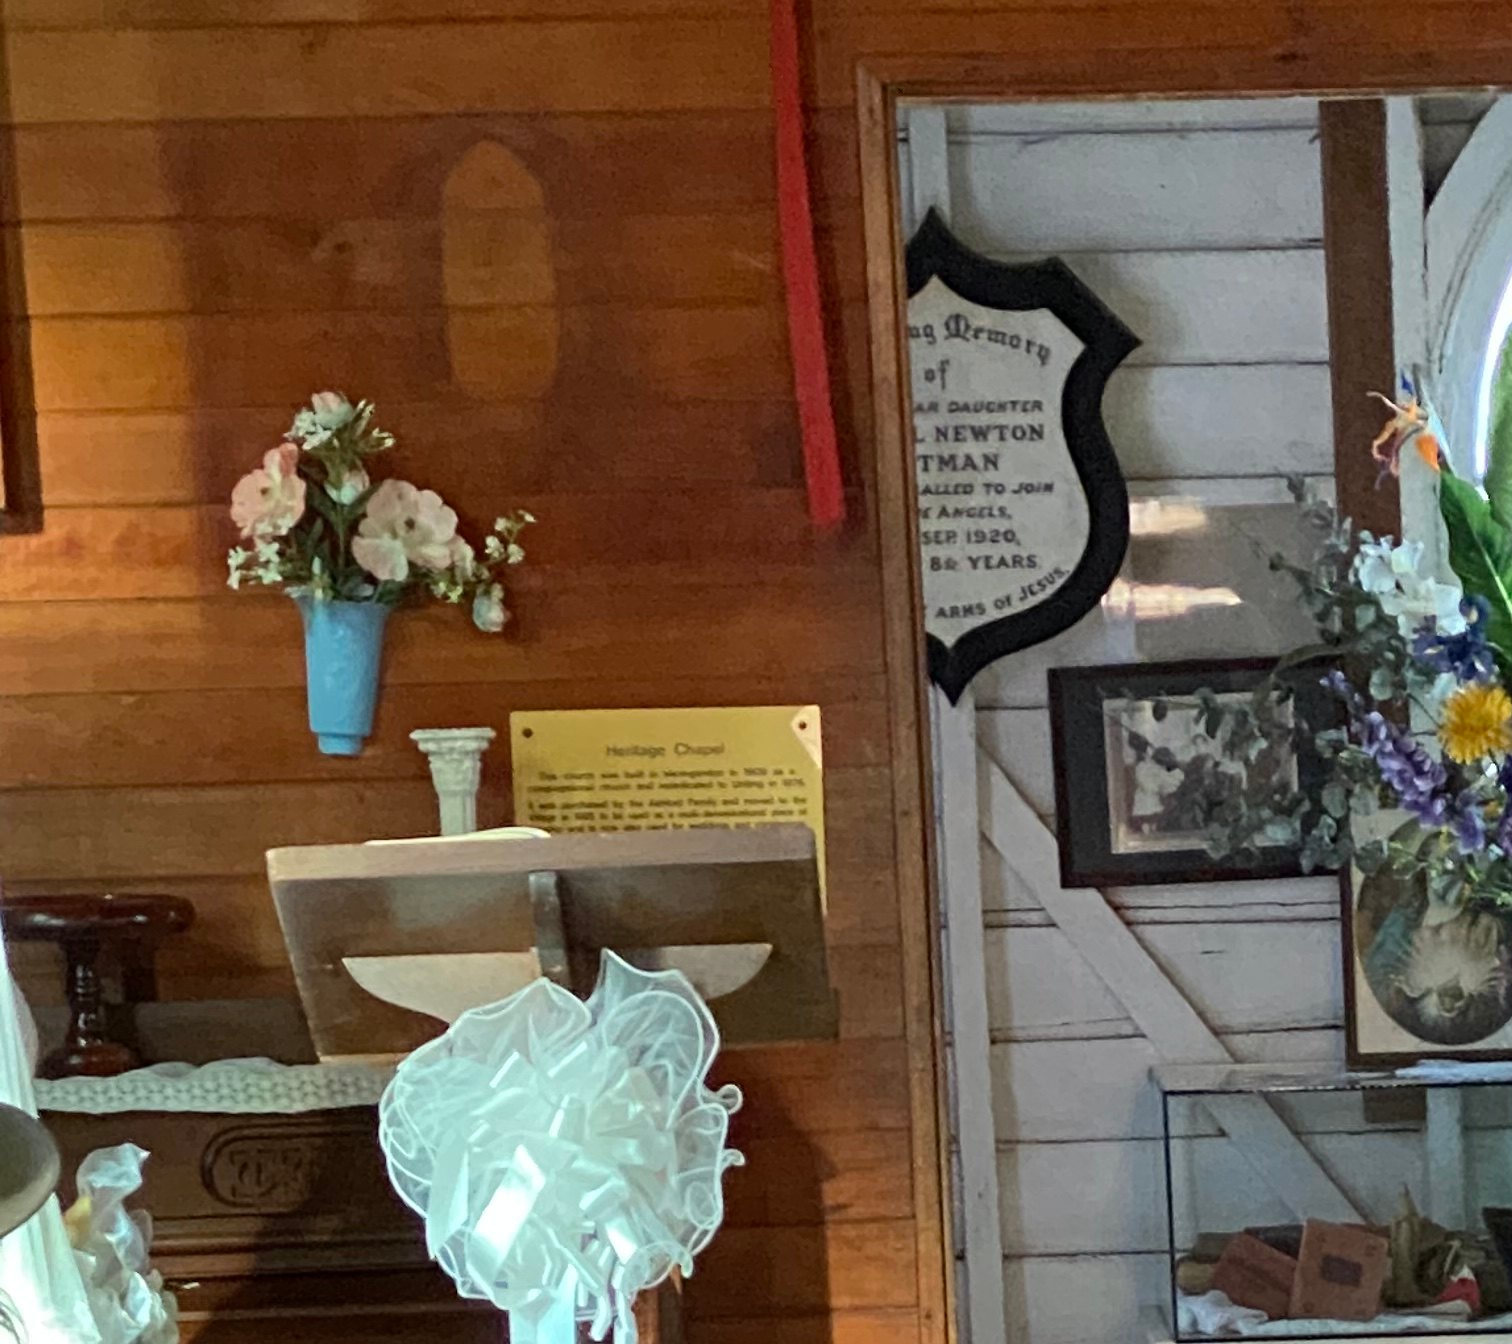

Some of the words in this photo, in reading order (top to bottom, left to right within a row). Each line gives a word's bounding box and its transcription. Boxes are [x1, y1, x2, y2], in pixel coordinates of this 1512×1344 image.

[944, 313, 1051, 367] Memory
[923, 359, 950, 389] of
[947, 400, 1043, 413] DAUGHTER
[935, 424, 1044, 443] NEWTON
[917, 453, 1000, 472] TMAN
[982, 482, 1006, 495] TO
[1011, 481, 1055, 495] JOIN
[935, 603, 987, 619] ARMS
[993, 593, 1012, 611] OF
[606, 745, 666, 759] Heritage
[673, 742, 726, 756] Chapel
